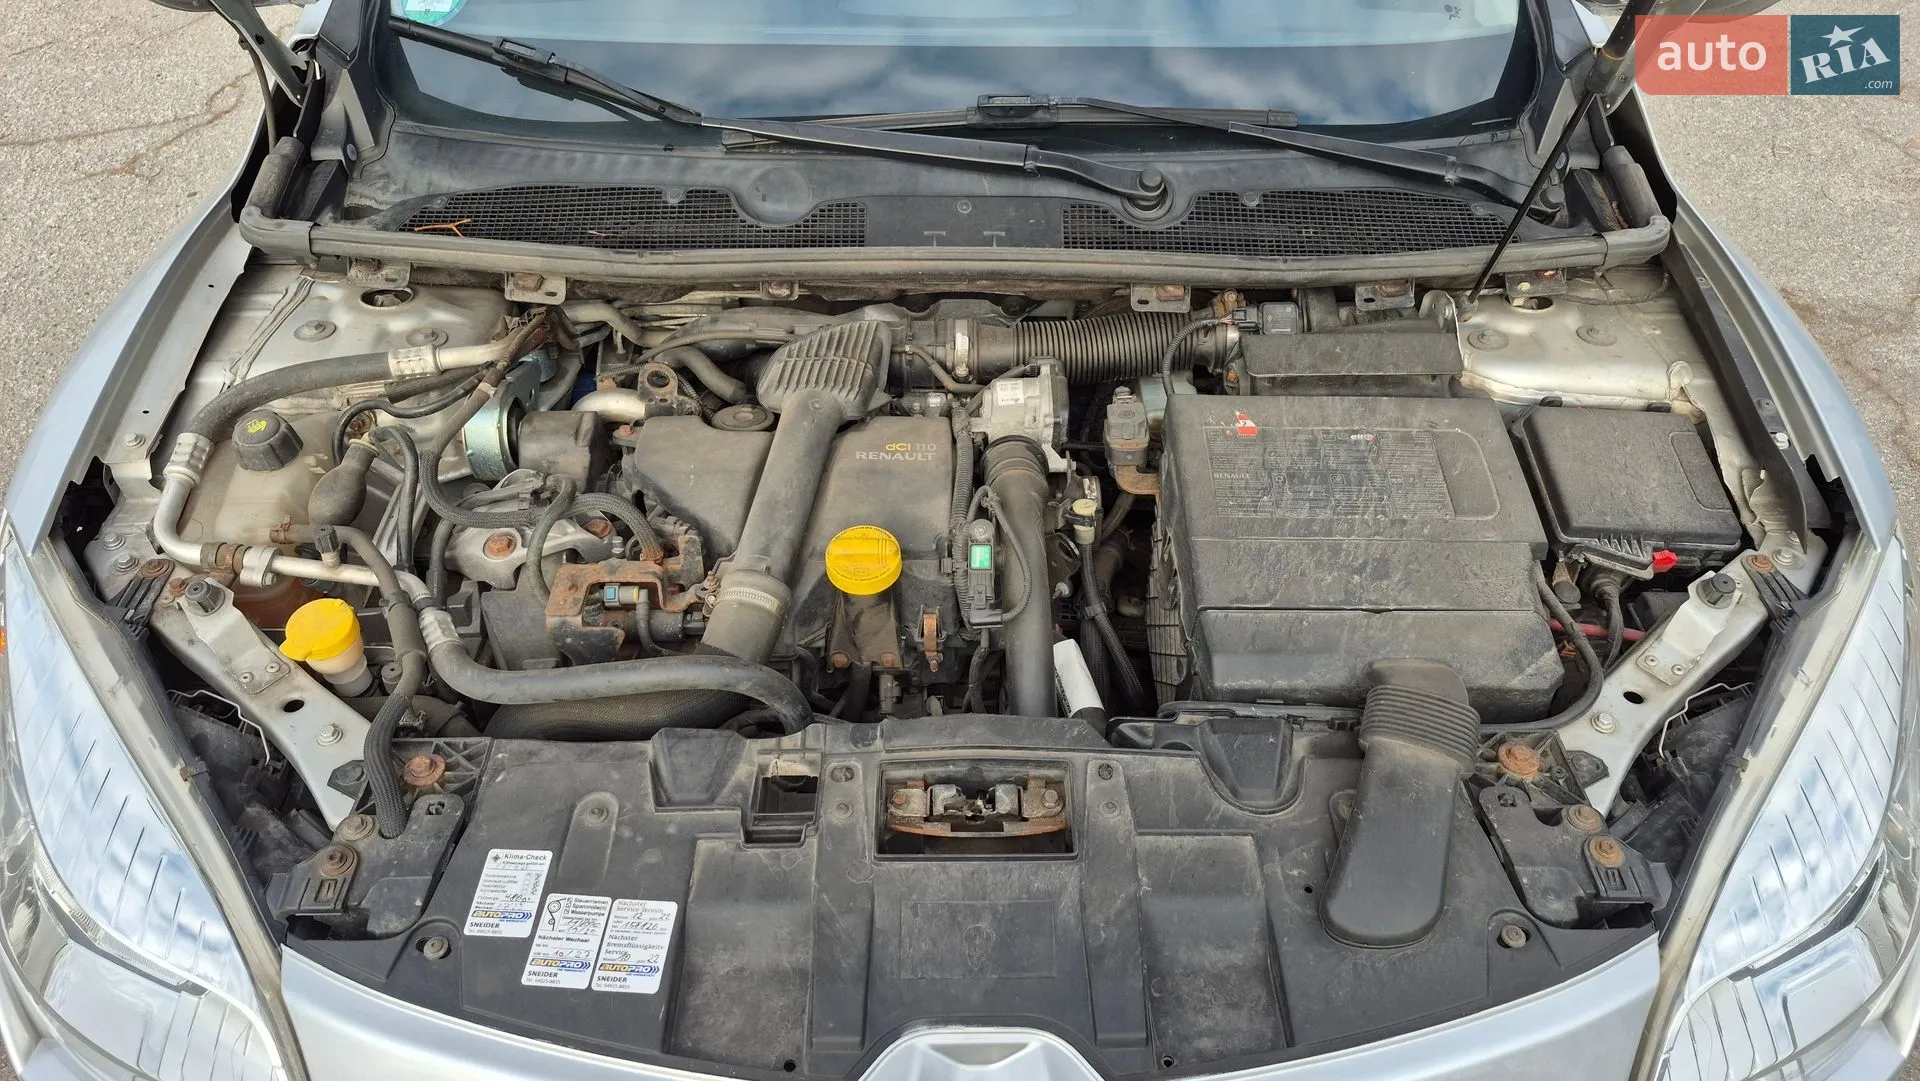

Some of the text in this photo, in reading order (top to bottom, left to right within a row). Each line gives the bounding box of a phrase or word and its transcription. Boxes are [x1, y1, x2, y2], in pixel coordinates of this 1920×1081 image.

[914, 443, 937, 451] 110
[855, 451, 937, 461] RENAULT
[504, 852, 547, 861] Klima-Check
[617, 900, 648, 908] Nächster
[632, 912, 643, 920] 12
[470, 921, 500, 929] SNEIDER
[527, 970, 559, 978] SNEIDER
[596, 975, 628, 983] SNEIDER
